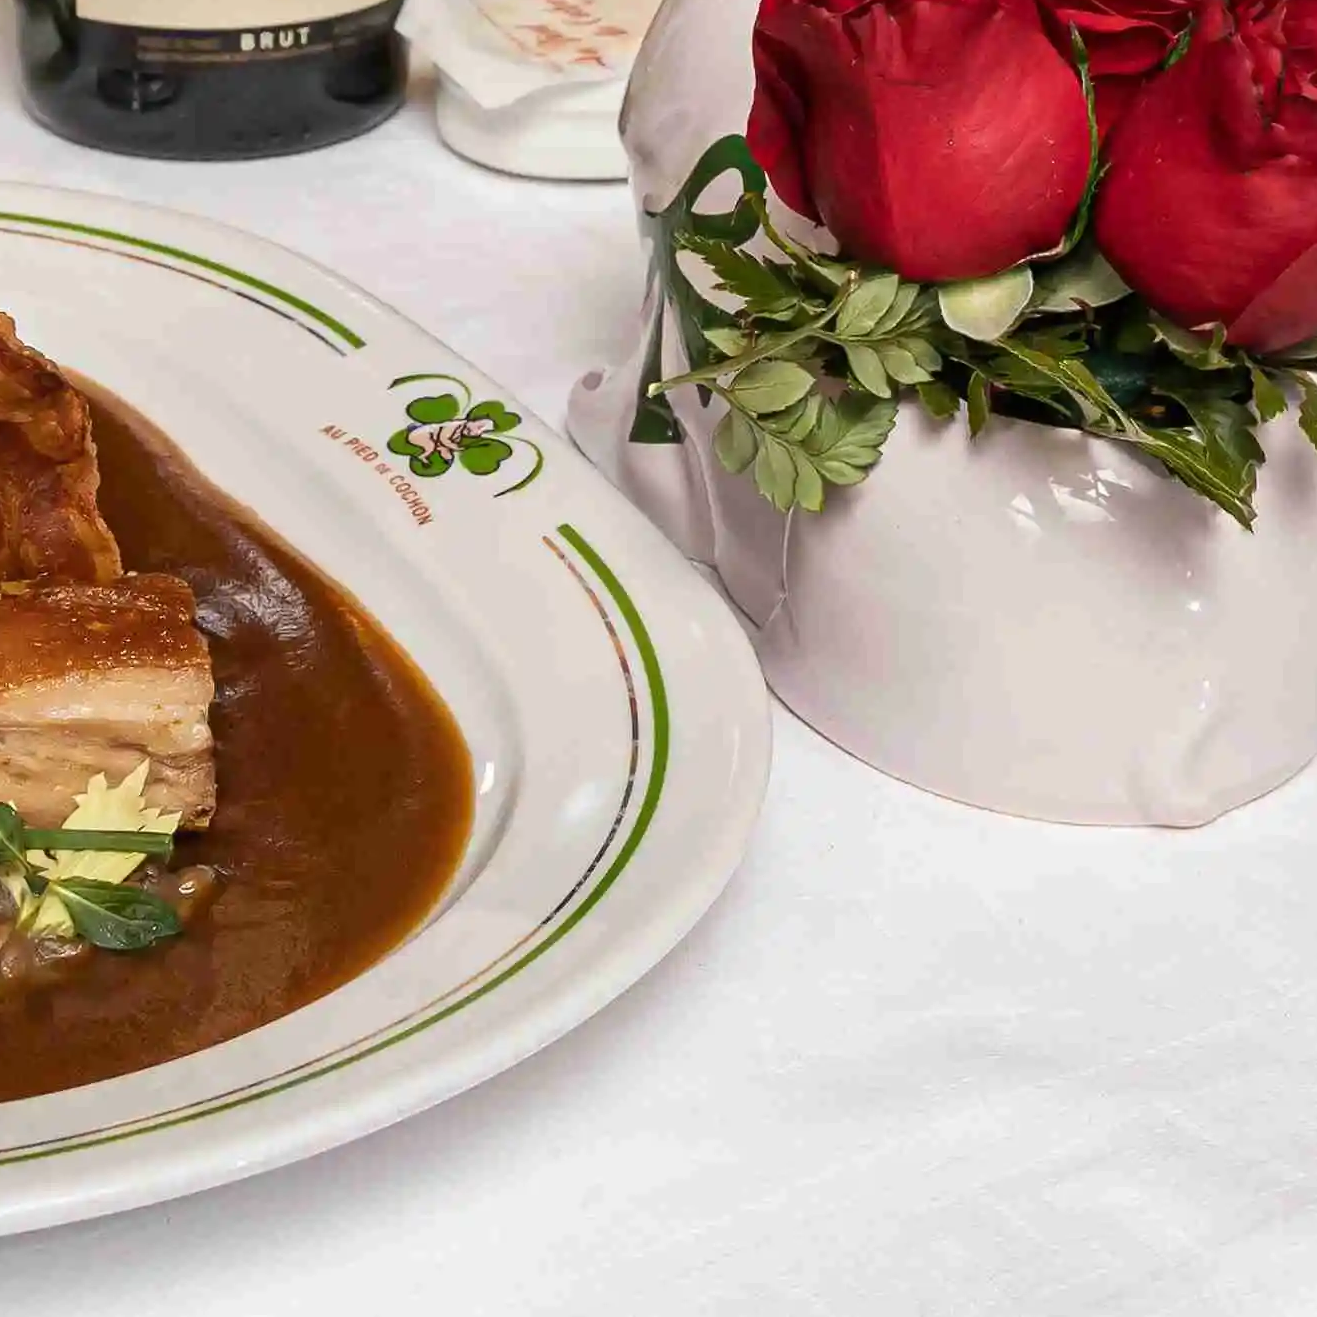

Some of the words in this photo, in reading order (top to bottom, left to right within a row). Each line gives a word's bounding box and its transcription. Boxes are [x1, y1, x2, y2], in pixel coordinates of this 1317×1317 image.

[239, 27, 310, 52] BRUT
[320, 425, 347, 440] AU
[344, 437, 379, 462] PIED
[389, 475, 433, 526] COCHON
